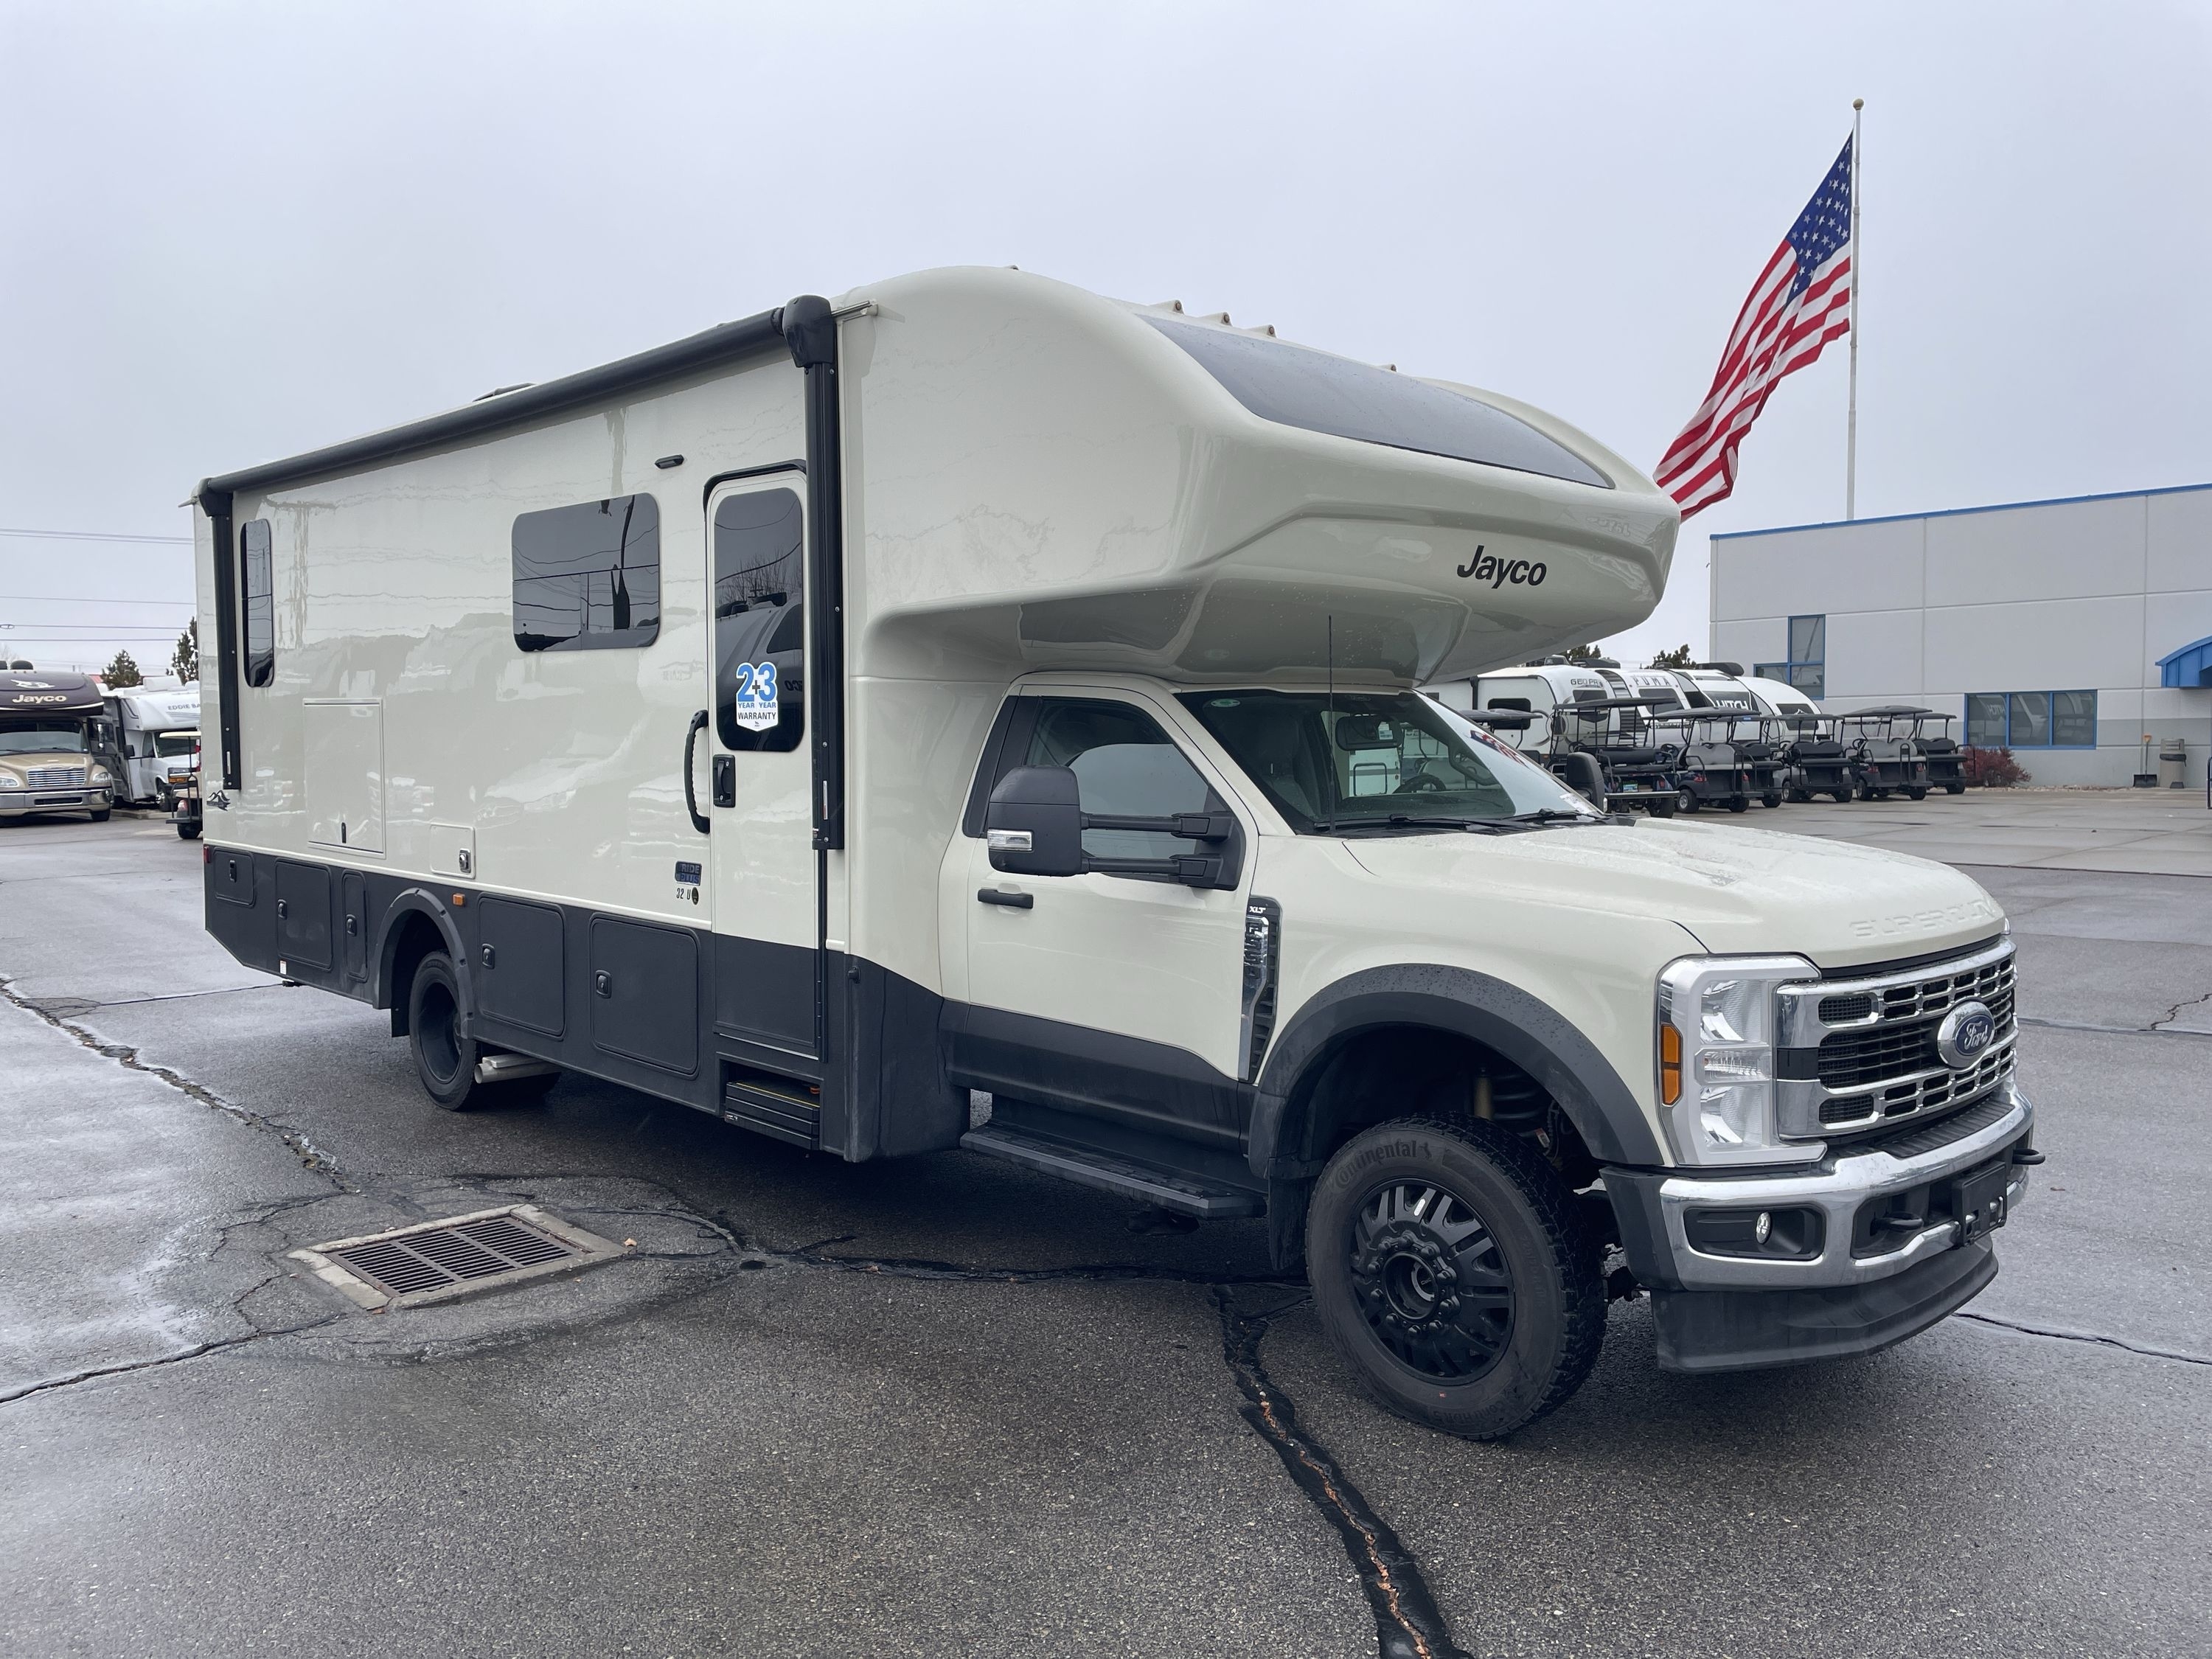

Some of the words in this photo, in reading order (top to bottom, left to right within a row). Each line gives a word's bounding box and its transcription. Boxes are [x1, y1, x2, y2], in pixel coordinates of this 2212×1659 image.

[1457, 545, 1547, 589] Jayco
[1633, 677, 1672, 686] PUMA
[12, 695, 67, 704] Jayco
[738, 712, 776, 720] WARRANTY
[1249, 905, 1267, 914] XLT
[1964, 1020, 1989, 1050] Ford
[1329, 1140, 1417, 1191] Continental
